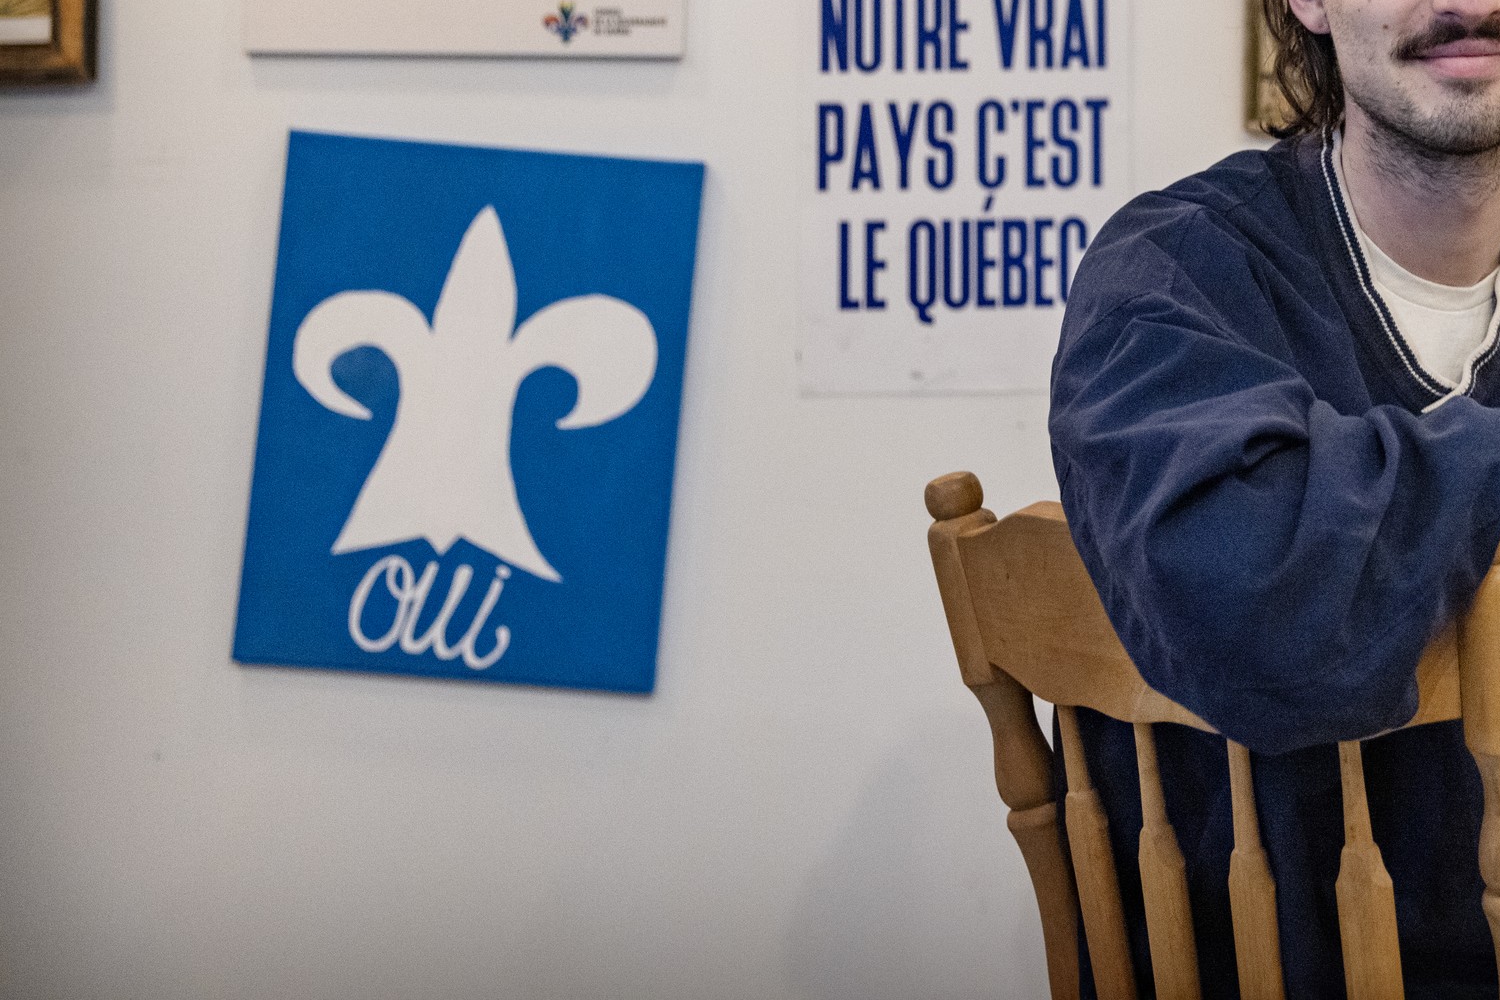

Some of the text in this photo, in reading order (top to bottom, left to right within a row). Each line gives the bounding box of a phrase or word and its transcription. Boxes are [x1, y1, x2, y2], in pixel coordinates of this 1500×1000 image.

[817, 97, 1110, 191] PAYS C'EST
[839, 219, 888, 310] LE
